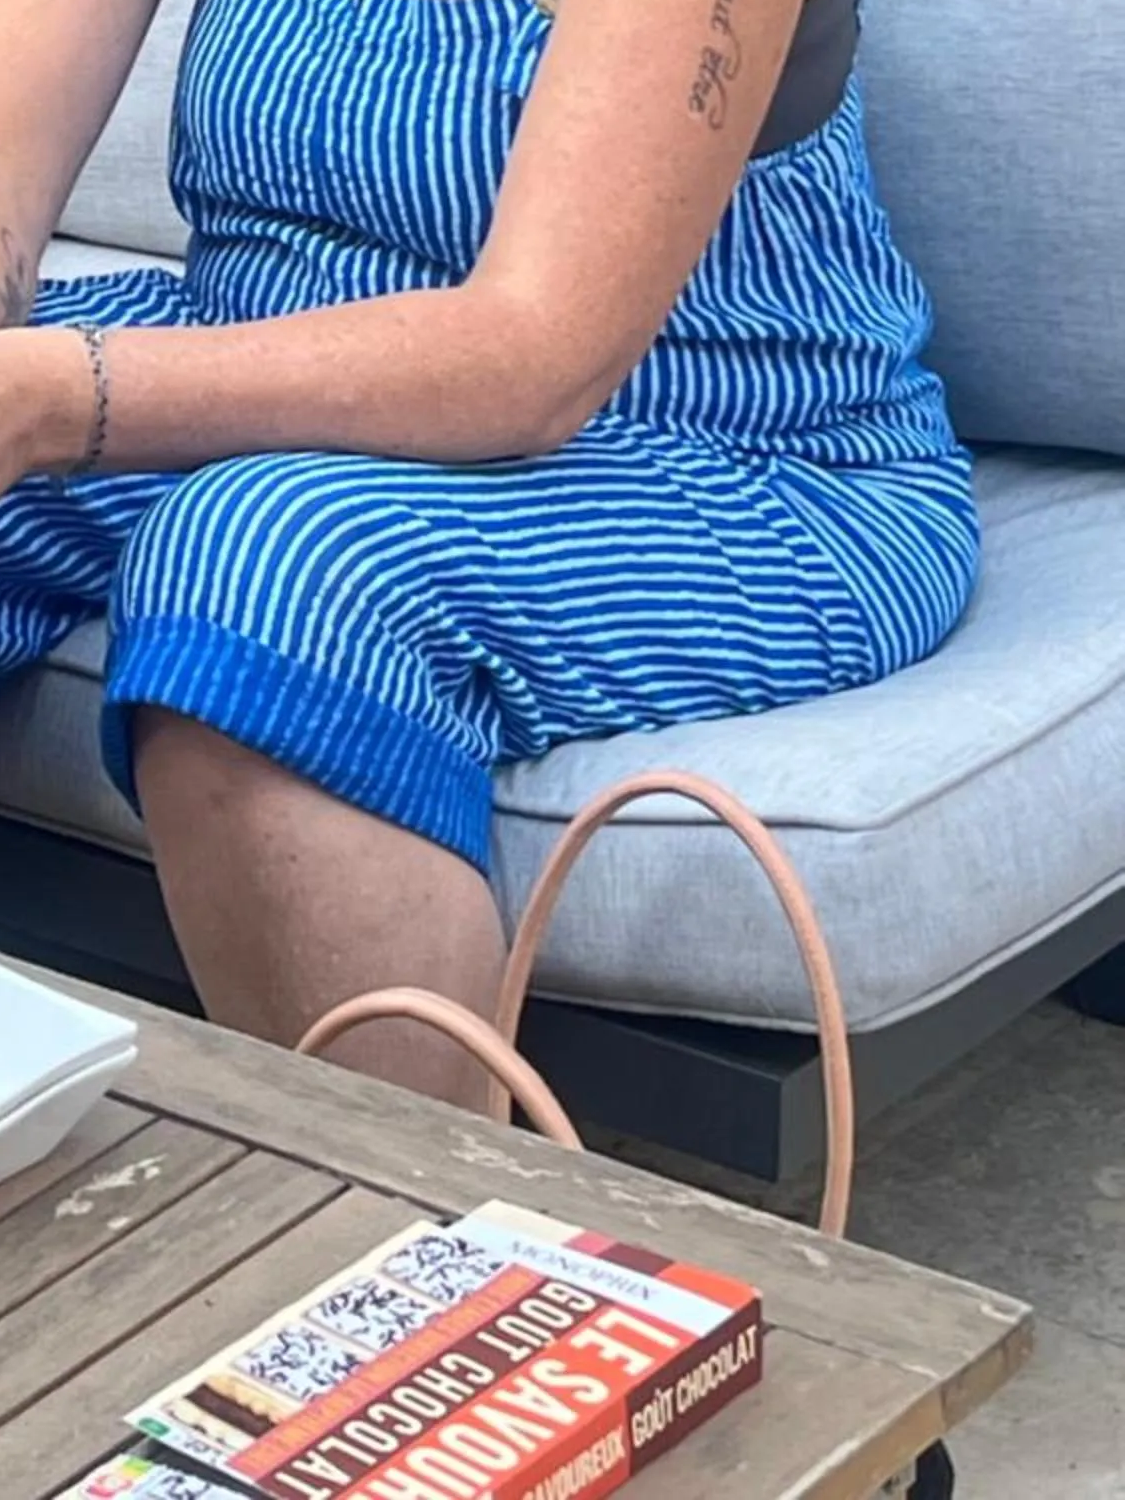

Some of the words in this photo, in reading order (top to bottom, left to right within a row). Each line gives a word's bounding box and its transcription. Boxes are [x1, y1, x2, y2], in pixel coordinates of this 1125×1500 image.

[476, 1281, 597, 1363] GOÛT
[569, 1308, 680, 1376] LE
[275, 1352, 496, 1500] CHOCOLAT
[347, 1357, 611, 1500] SAVOUR
[523, 1425, 626, 1500] AVOUREUX
[631, 1387, 676, 1448] GOÛT
[675, 1325, 759, 1414] CHOCOLAT
